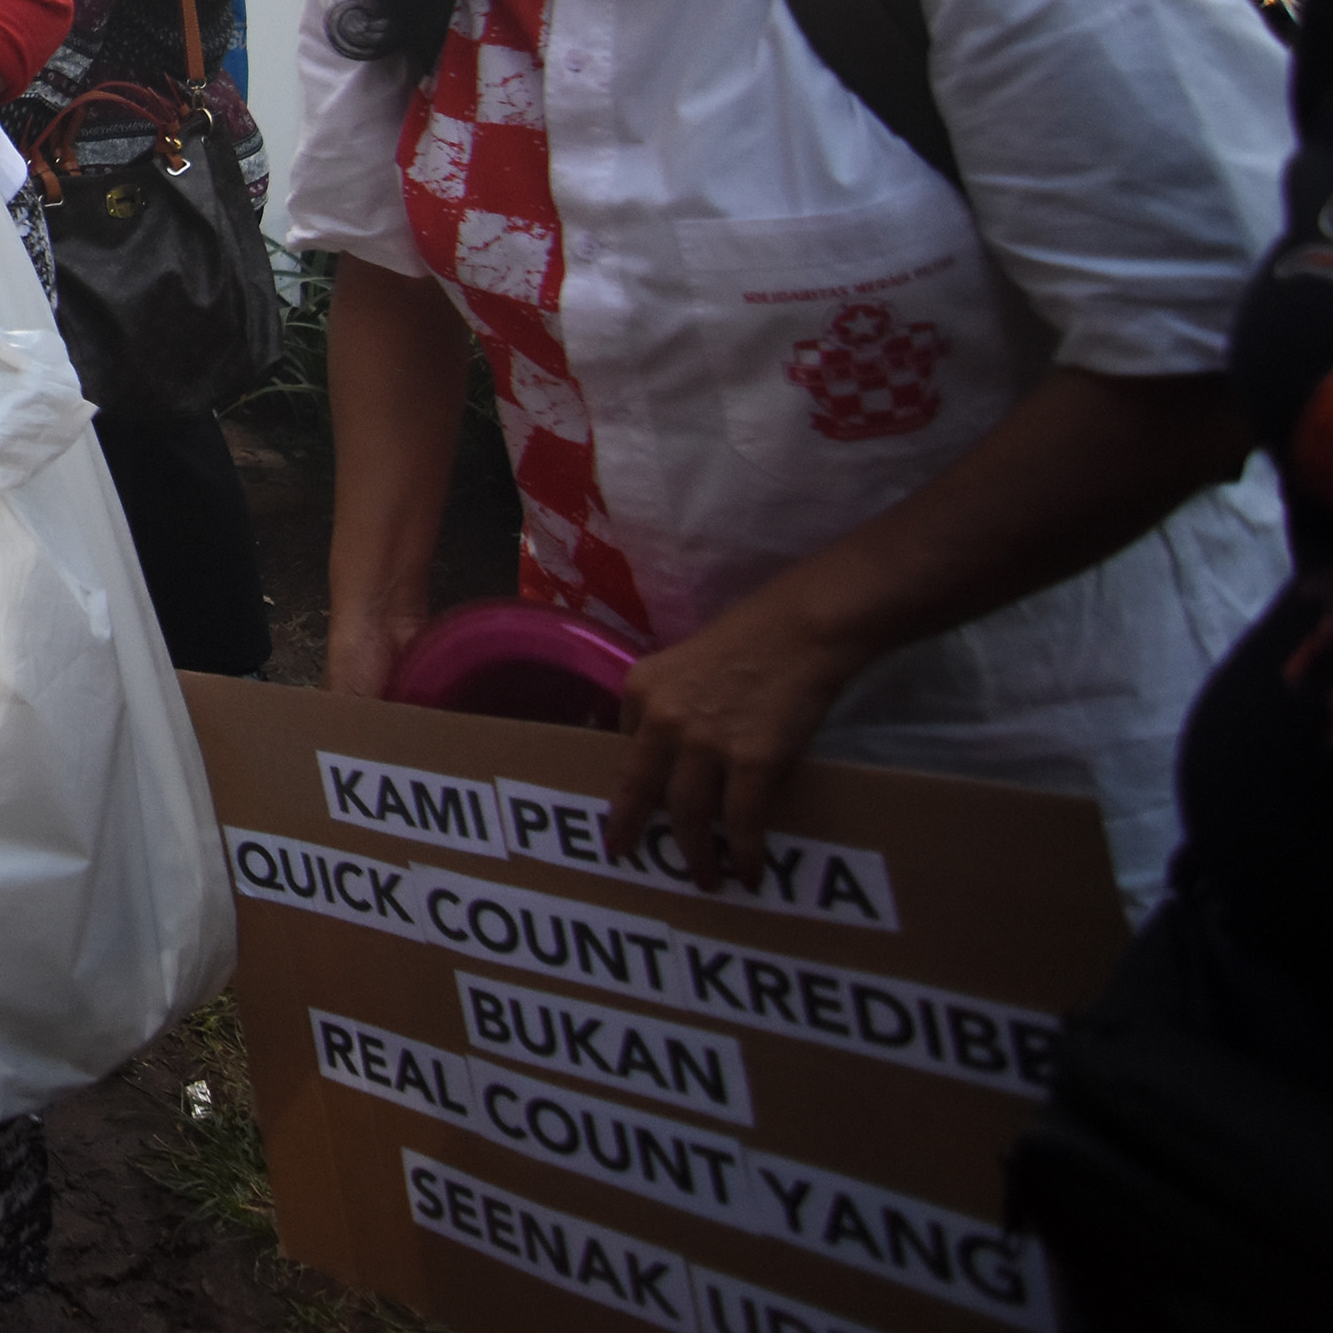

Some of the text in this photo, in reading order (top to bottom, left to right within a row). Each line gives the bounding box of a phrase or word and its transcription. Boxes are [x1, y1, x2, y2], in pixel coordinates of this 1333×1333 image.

[235, 840, 413, 925] QUICK
[427, 889, 670, 992] COUNT
[330, 765, 879, 920] KAMI PECYA
[468, 989, 730, 1106] BUKAN
[323, 1020, 1029, 1306] REAL COUNT YANG
[411, 1166, 679, 1321] SEENAK
